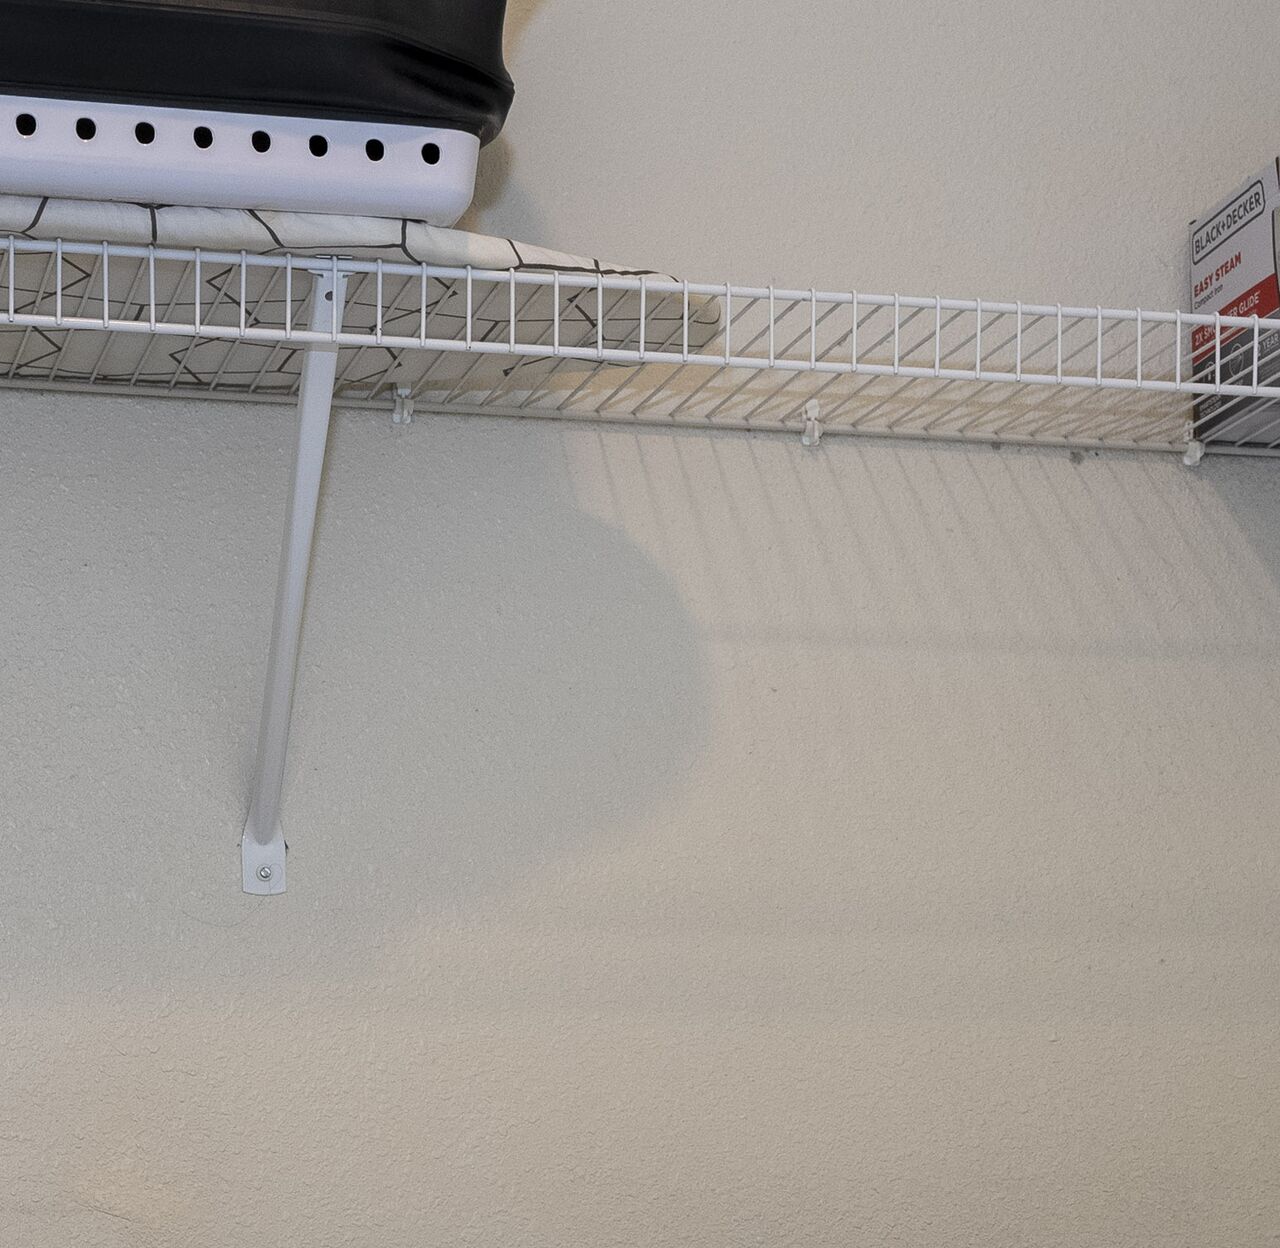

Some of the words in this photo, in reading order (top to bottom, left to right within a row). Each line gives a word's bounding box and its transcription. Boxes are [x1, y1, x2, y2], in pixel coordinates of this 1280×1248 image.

[1194, 191, 1262, 255] BLACK+DECKER
[1194, 274, 1213, 297] EASY
[1215, 252, 1242, 281] STEAM
[1239, 292, 1260, 314] GLIDE
